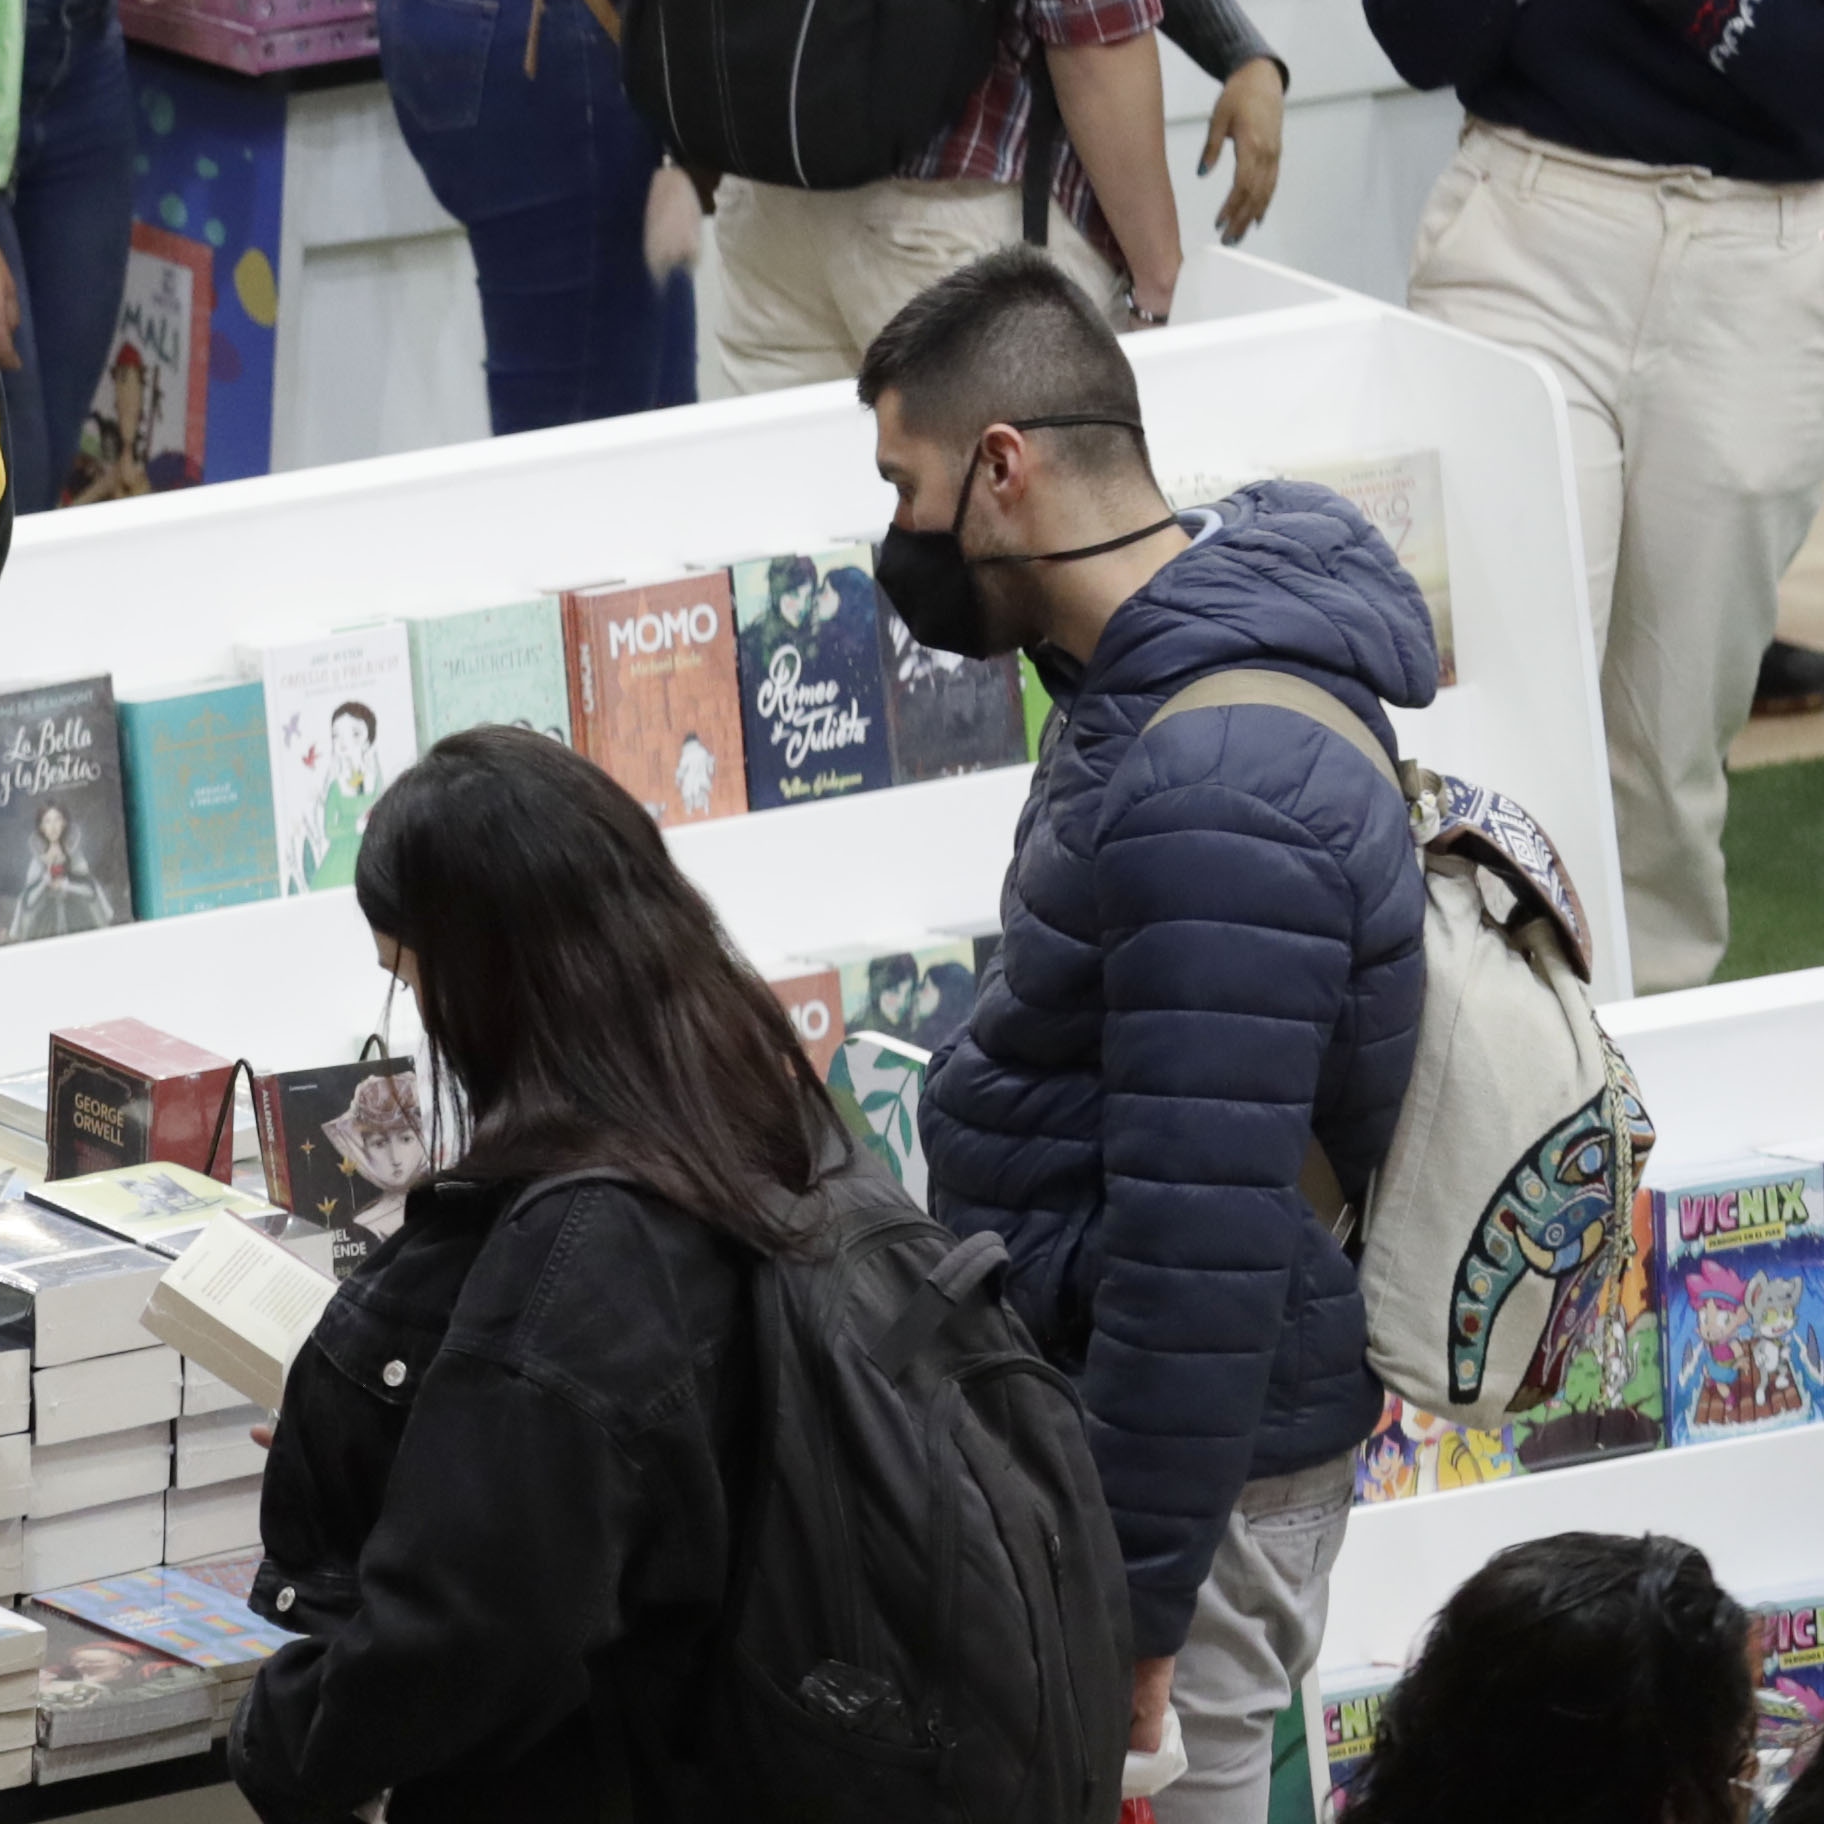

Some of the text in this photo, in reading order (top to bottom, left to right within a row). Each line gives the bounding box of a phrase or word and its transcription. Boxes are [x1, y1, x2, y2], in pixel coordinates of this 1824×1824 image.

[609, 603, 718, 661] MOMO
[757, 644, 839, 724] Romeo
[5, 717, 93, 764] La Bella
[785, 700, 871, 768] Julieta
[14, 762, 33, 789] la
[29, 753, 102, 796] Bestia
[73, 1110, 124, 1148] ORWELL
[75, 1092, 125, 1128] GEORGE
[262, 1089, 276, 1143] ALLENDE
[1679, 1176, 1809, 1242] VICNIX
[333, 1243, 367, 1260] ENDE
[1761, 1607, 1824, 1653] VIC
